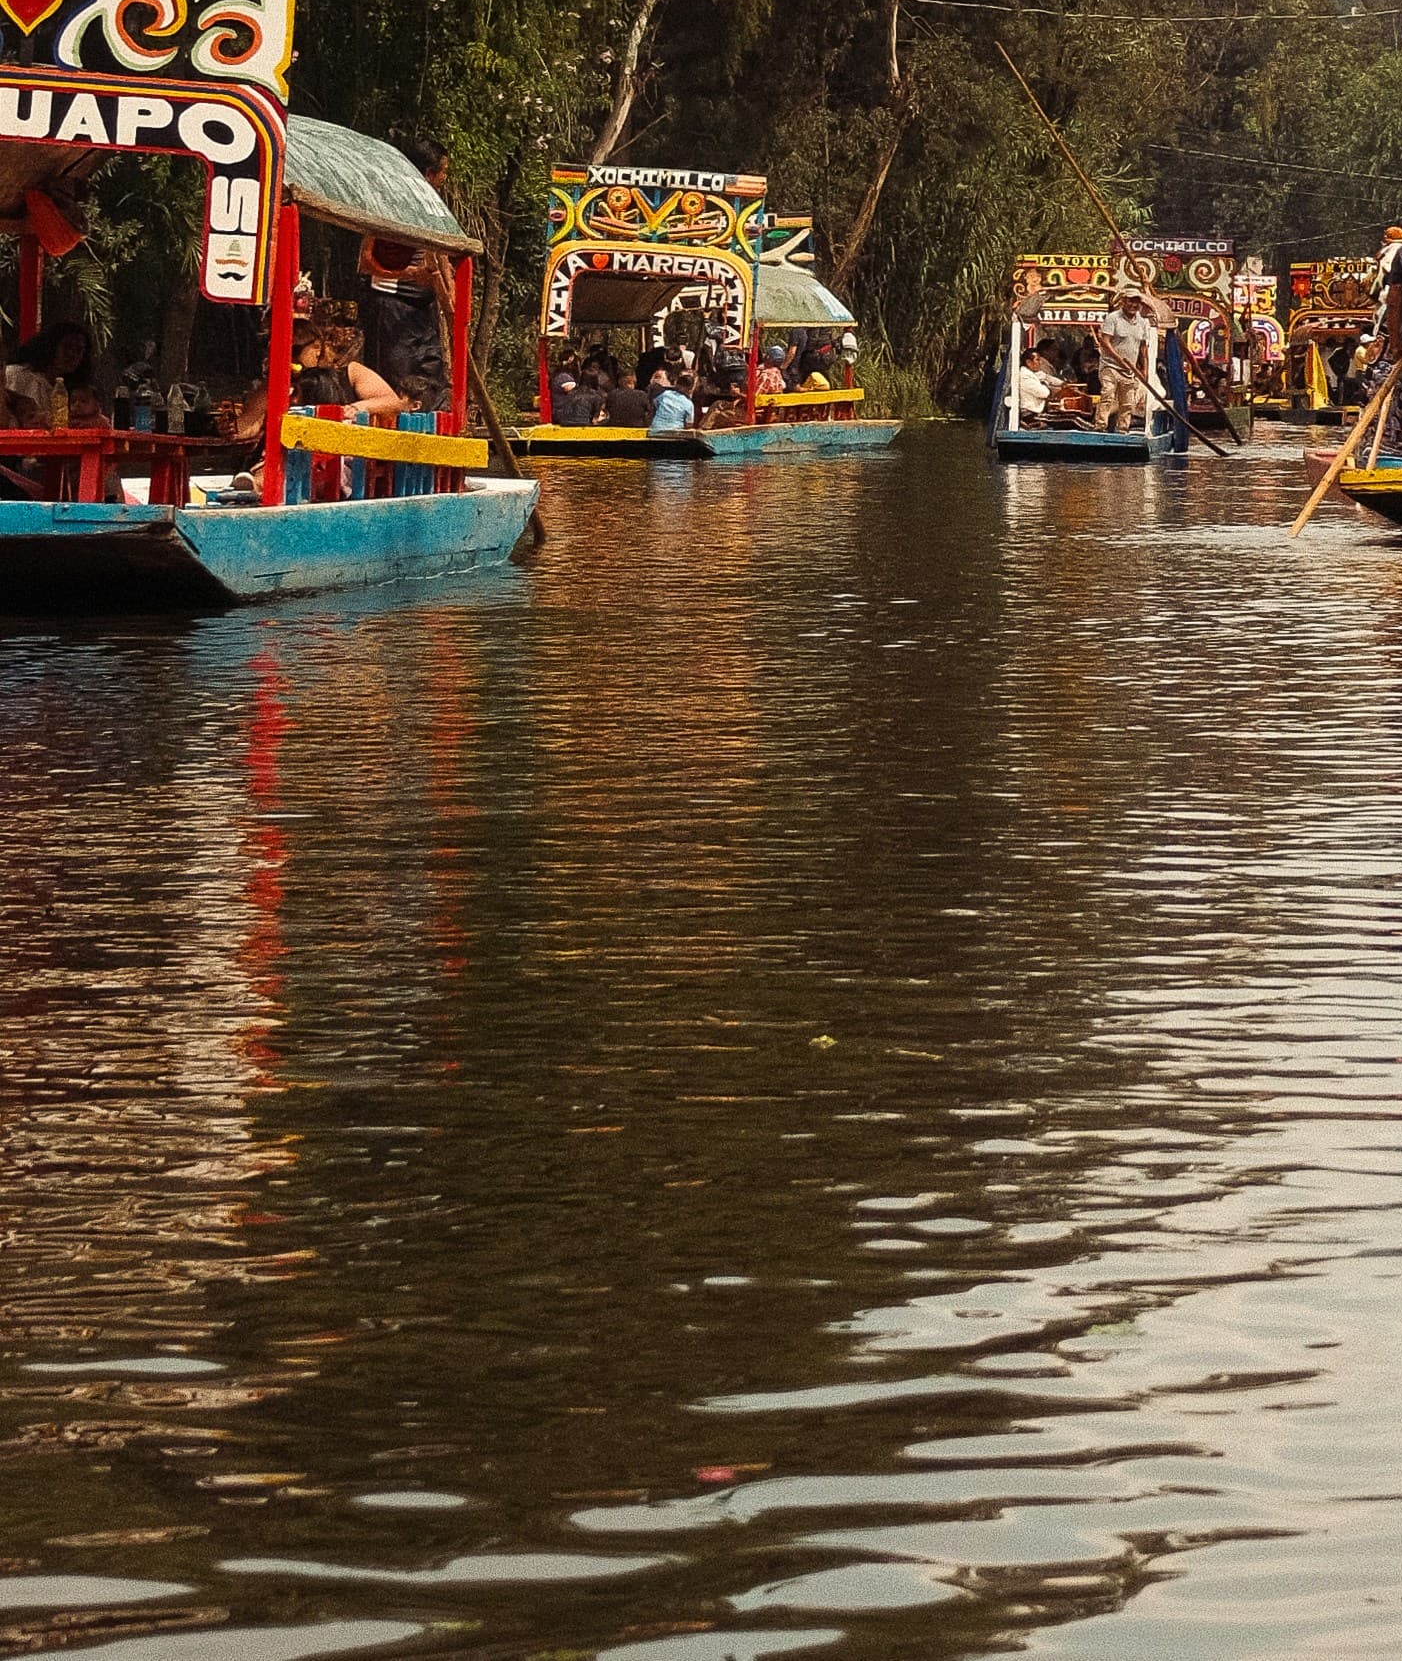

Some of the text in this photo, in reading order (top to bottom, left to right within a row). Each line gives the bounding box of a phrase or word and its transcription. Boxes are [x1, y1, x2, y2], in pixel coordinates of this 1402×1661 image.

[588, 166, 725, 191] XOCHIMILCO
[547, 255, 589, 331] VIVA
[612, 252, 743, 346] MARGARITA
